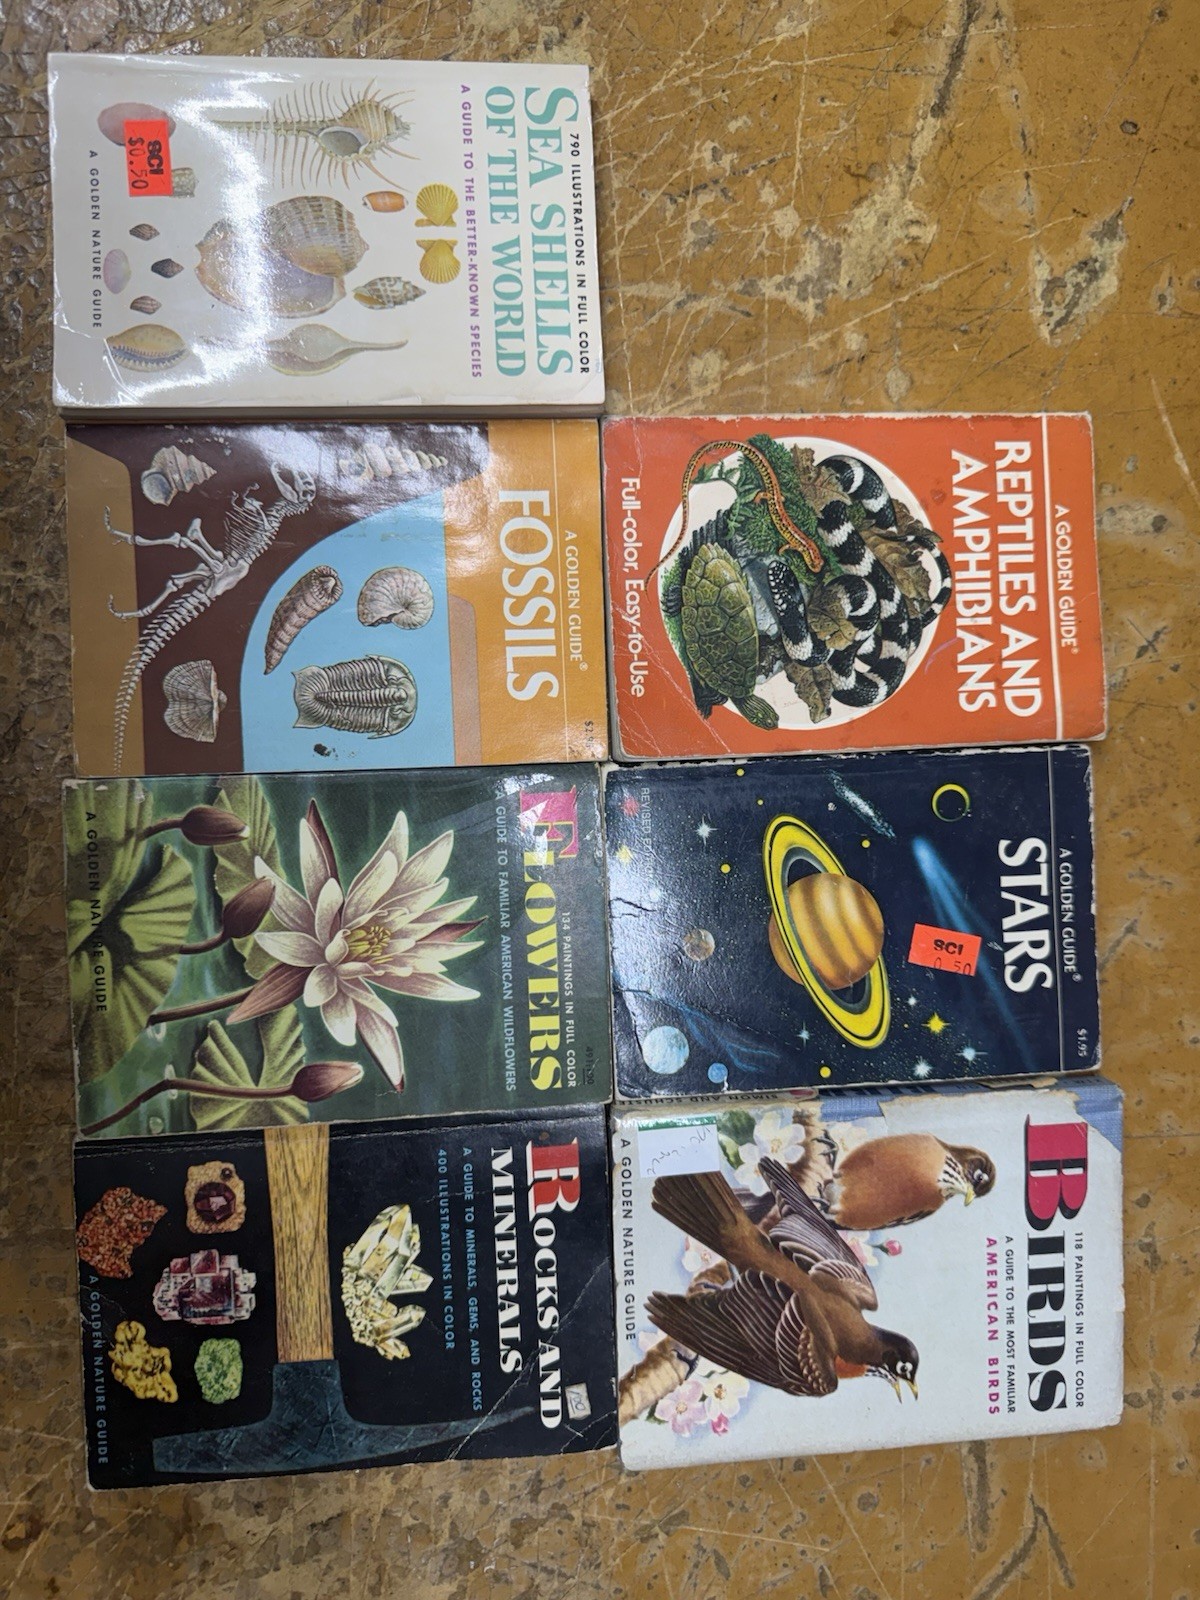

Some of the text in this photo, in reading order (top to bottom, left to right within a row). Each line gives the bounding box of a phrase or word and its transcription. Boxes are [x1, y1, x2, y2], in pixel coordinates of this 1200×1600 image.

[89, 150, 102, 328] A GOLDEN NATURE GUIDE
[128, 137, 149, 189] $0.50
[147, 140, 164, 175] SCI
[461, 85, 482, 378] A GUIDE TO THE BETTER-KNOWN SPECIES
[485, 86, 526, 376] OF THE WORLD
[524, 87, 579, 376] SEA SHELLS
[570, 133, 590, 374] 790 ILLUSTRATIONS IN FULL COLOR
[565, 530, 577, 541] A
[565, 545, 580, 609] GOLDEN
[621, 477, 648, 697] Full-color, Easy-to-Use
[951, 450, 996, 712] AMPHIBIANS
[995, 440, 1042, 717] REPTILES AND
[1055, 505, 1070, 518] A
[1056, 521, 1073, 591] GOLDEN
[499, 490, 559, 701] FOSSILS
[86, 812, 96, 822] A
[87, 829, 100, 891] GOLDEN
[641, 787, 651, 834] REVISED
[1059, 848, 1070, 858] A
[1059, 862, 1074, 922] GOLDEN
[94, 965, 107, 1012] GUIDE
[495, 790, 516, 1091] A GUIDE TO FAMILIAR AMERICAN WILDFLOWERS
[519, 784, 580, 1090] FLOWERS
[933, 939, 964, 955] SCI
[998, 837, 1053, 992] STARS
[562, 912, 576, 1087] 134 PAINTINGS IN FULL COLOR
[1076, 1028, 1088, 1057] $1.95
[463, 1148, 472, 1156] A
[463, 1164, 474, 1200] GUIDE
[464, 1206, 474, 1222] TO
[437, 1149, 454, 1349] 400 ILLUSTRATIONS IN COLOR
[467, 1297, 479, 1332] GEMS,
[490, 1148, 523, 1374] MINERALS
[526, 1137, 581, 1428] ROCKS AND
[621, 1138, 636, 1341] A GOLDEN NATURE GUIDE
[1024, 1114, 1088, 1412] BIRDS
[1074, 1232, 1084, 1408] 118 PAINTINGS IN FULL COLOR
[89, 1275, 108, 1464] A GOLDEN NATURE GUIDE
[470, 1339, 480, 1365] AND
[471, 1372, 482, 1411] ROCKS
[986, 1238, 1000, 1415] AMERICAN BIRDS
[1005, 1236, 1016, 1413] A GUIDE TO THE MOST FAMILIAR
